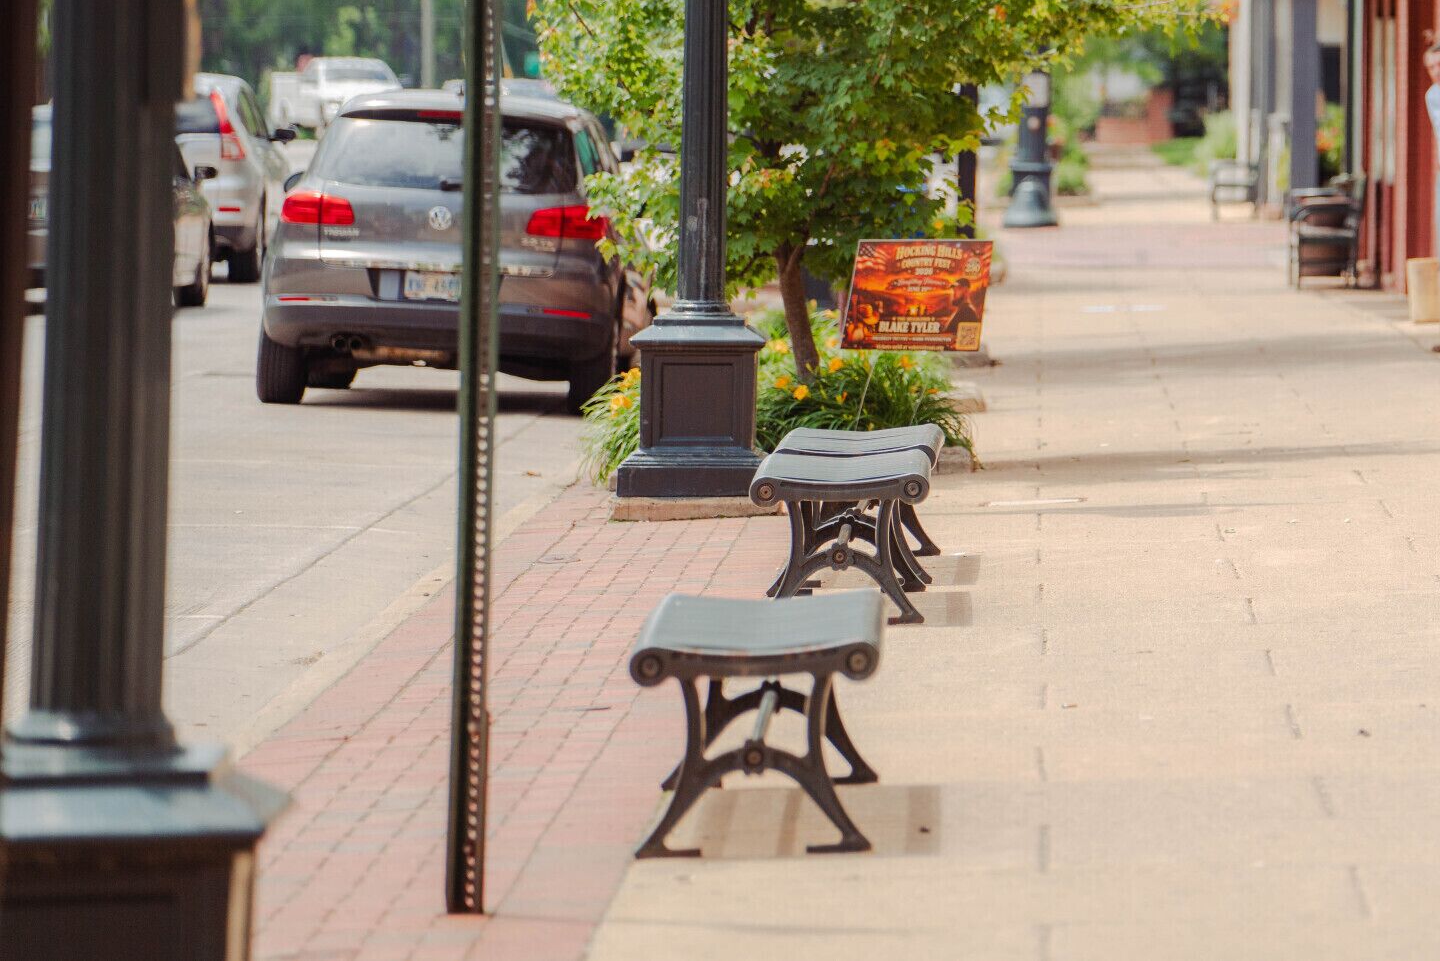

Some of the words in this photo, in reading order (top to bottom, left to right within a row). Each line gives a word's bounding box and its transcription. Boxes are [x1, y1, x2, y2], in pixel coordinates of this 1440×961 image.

[896, 245, 936, 260] HOCKING
[937, 244, 963, 260] HILLS
[901, 257, 934, 269] COUNTRY
[878, 321, 910, 333] BLAKE
[910, 321, 941, 334] TYLER
